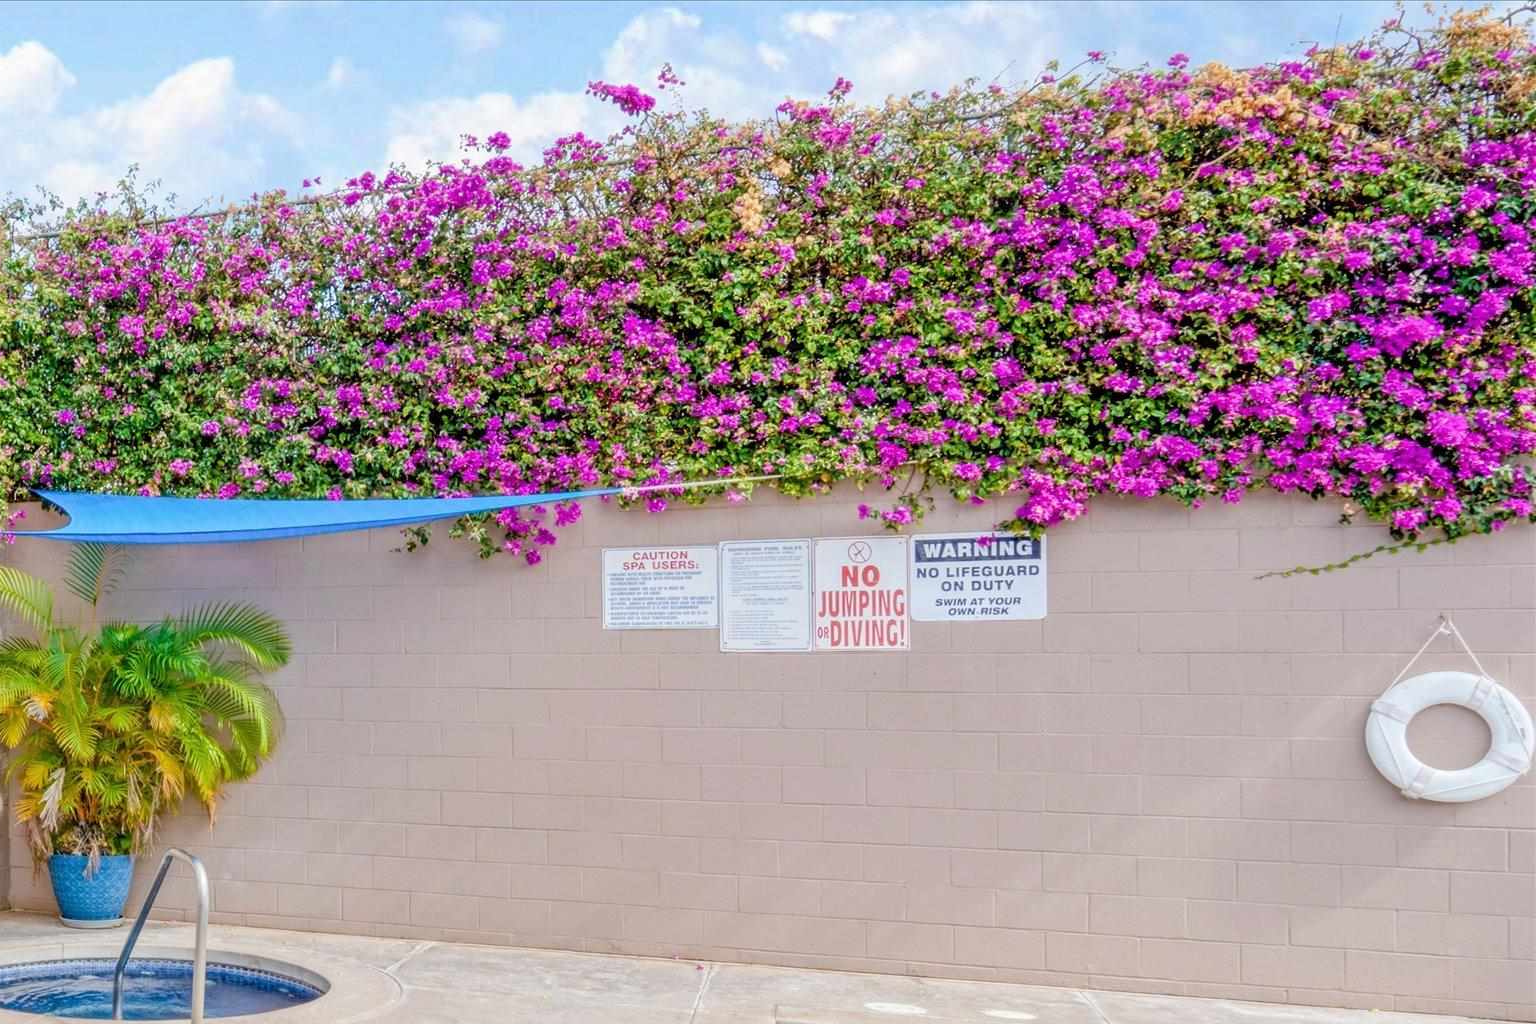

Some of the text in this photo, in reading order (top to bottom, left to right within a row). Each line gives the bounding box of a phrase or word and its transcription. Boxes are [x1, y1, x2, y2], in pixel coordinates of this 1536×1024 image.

[923, 540, 1033, 558] WARNING
[632, 551, 688, 561] CAUTION
[623, 560, 700, 571] SPA USERS:
[916, 565, 1040, 578] NO LIFEGUARD
[841, 565, 881, 587] NO
[941, 579, 1014, 591] ON DUTY
[818, 589, 905, 617] JUMPING
[935, 597, 1022, 607] SWIM AT YOUR
[948, 607, 1009, 616] OWN RISK
[817, 619, 905, 647] OR DIVING!
